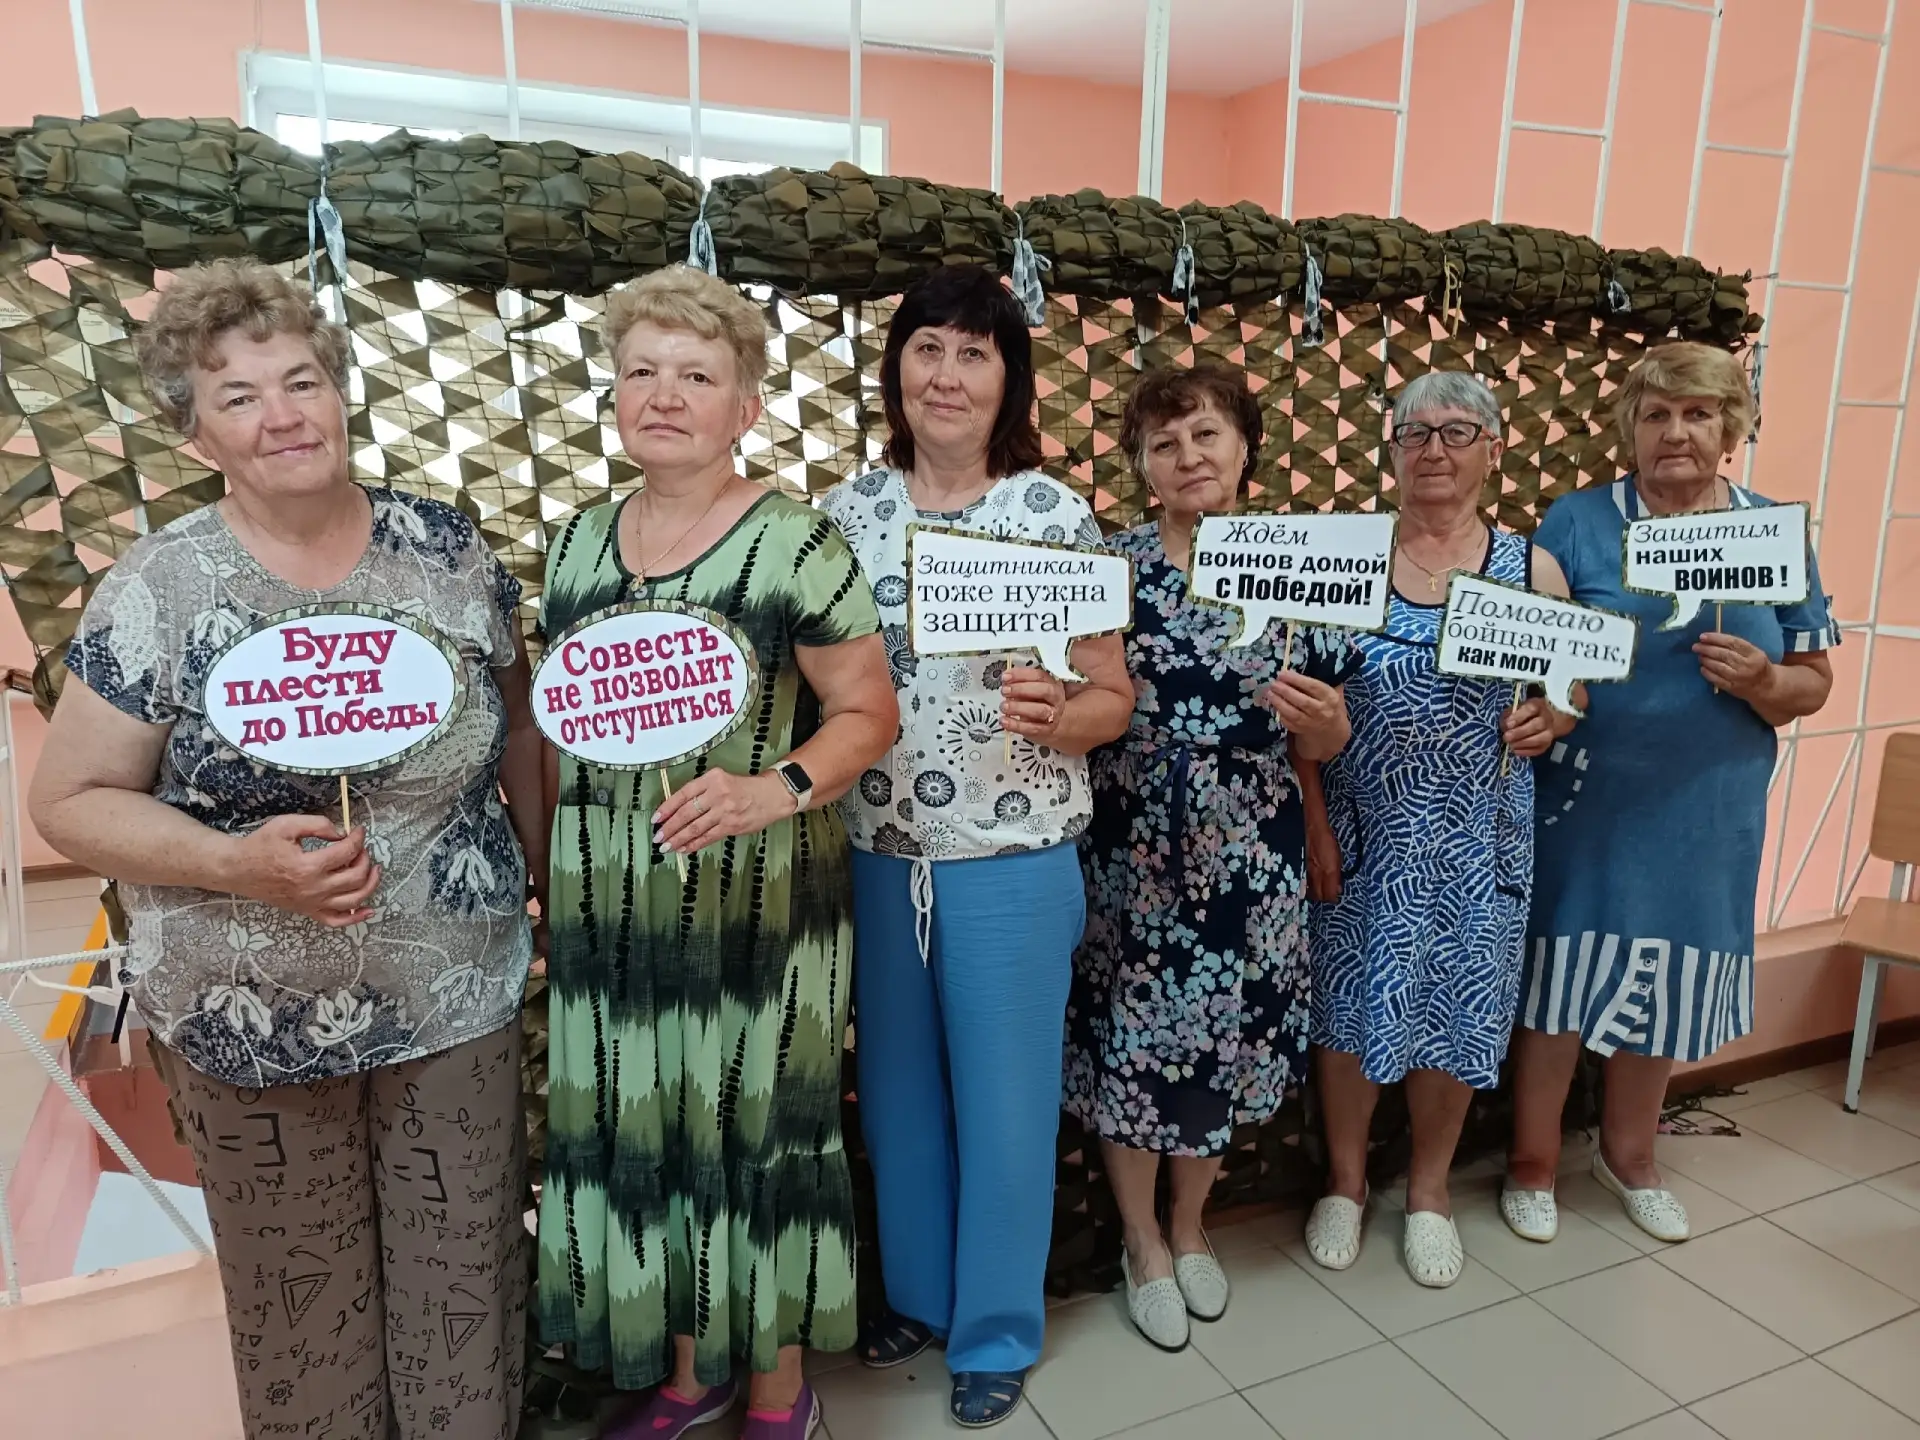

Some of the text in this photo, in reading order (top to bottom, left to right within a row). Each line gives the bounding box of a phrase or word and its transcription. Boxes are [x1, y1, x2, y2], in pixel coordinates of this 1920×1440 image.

[1221, 521, 1309, 546] Ждём
[1633, 523, 1780, 544] Защитим
[917, 554, 1095, 579] Защитникам
[1198, 551, 1387, 575] воинов домой
[1636, 547, 1725, 565] наших
[917, 583, 1108, 608] тоже нужна
[1216, 573, 1373, 607] с Победой!
[922, 605, 1070, 637] защита!
[1451, 590, 1605, 634] Помогаю
[279, 626, 398, 670] Буду
[562, 626, 719, 677] Совесть
[1448, 616, 1627, 666] бойцам так,
[1457, 645, 1552, 676] как могу
[223, 669, 384, 707] плести
[543, 653, 735, 714] не позволит
[239, 697, 439, 748] до Победы
[560, 688, 735, 745] отступиться
